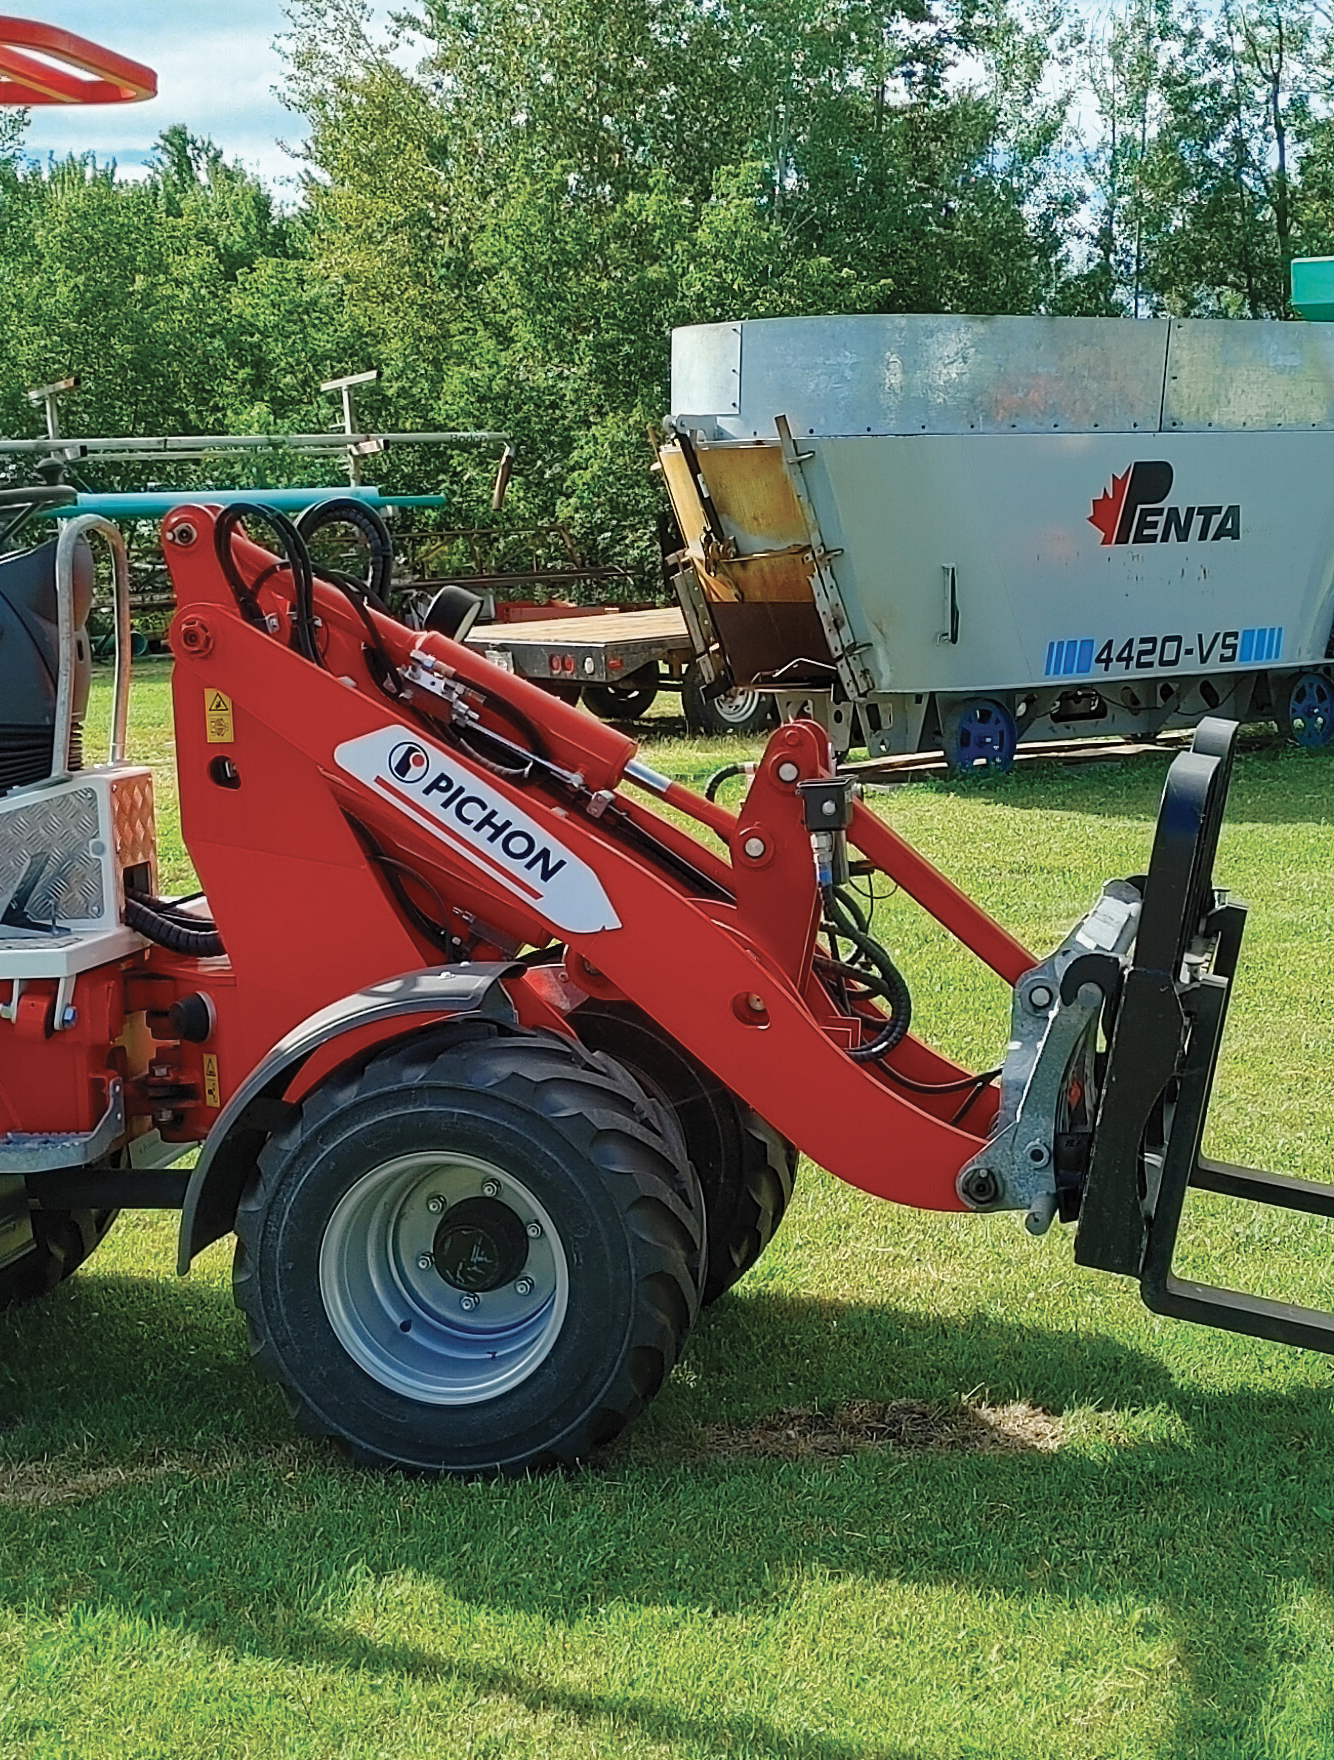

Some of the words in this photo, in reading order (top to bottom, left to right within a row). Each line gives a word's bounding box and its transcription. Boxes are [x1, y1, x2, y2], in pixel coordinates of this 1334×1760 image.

[1114, 461, 1240, 545] PENTA
[1094, 631, 1239, 672] 4420-VS
[421, 772, 567, 883] PICHON
